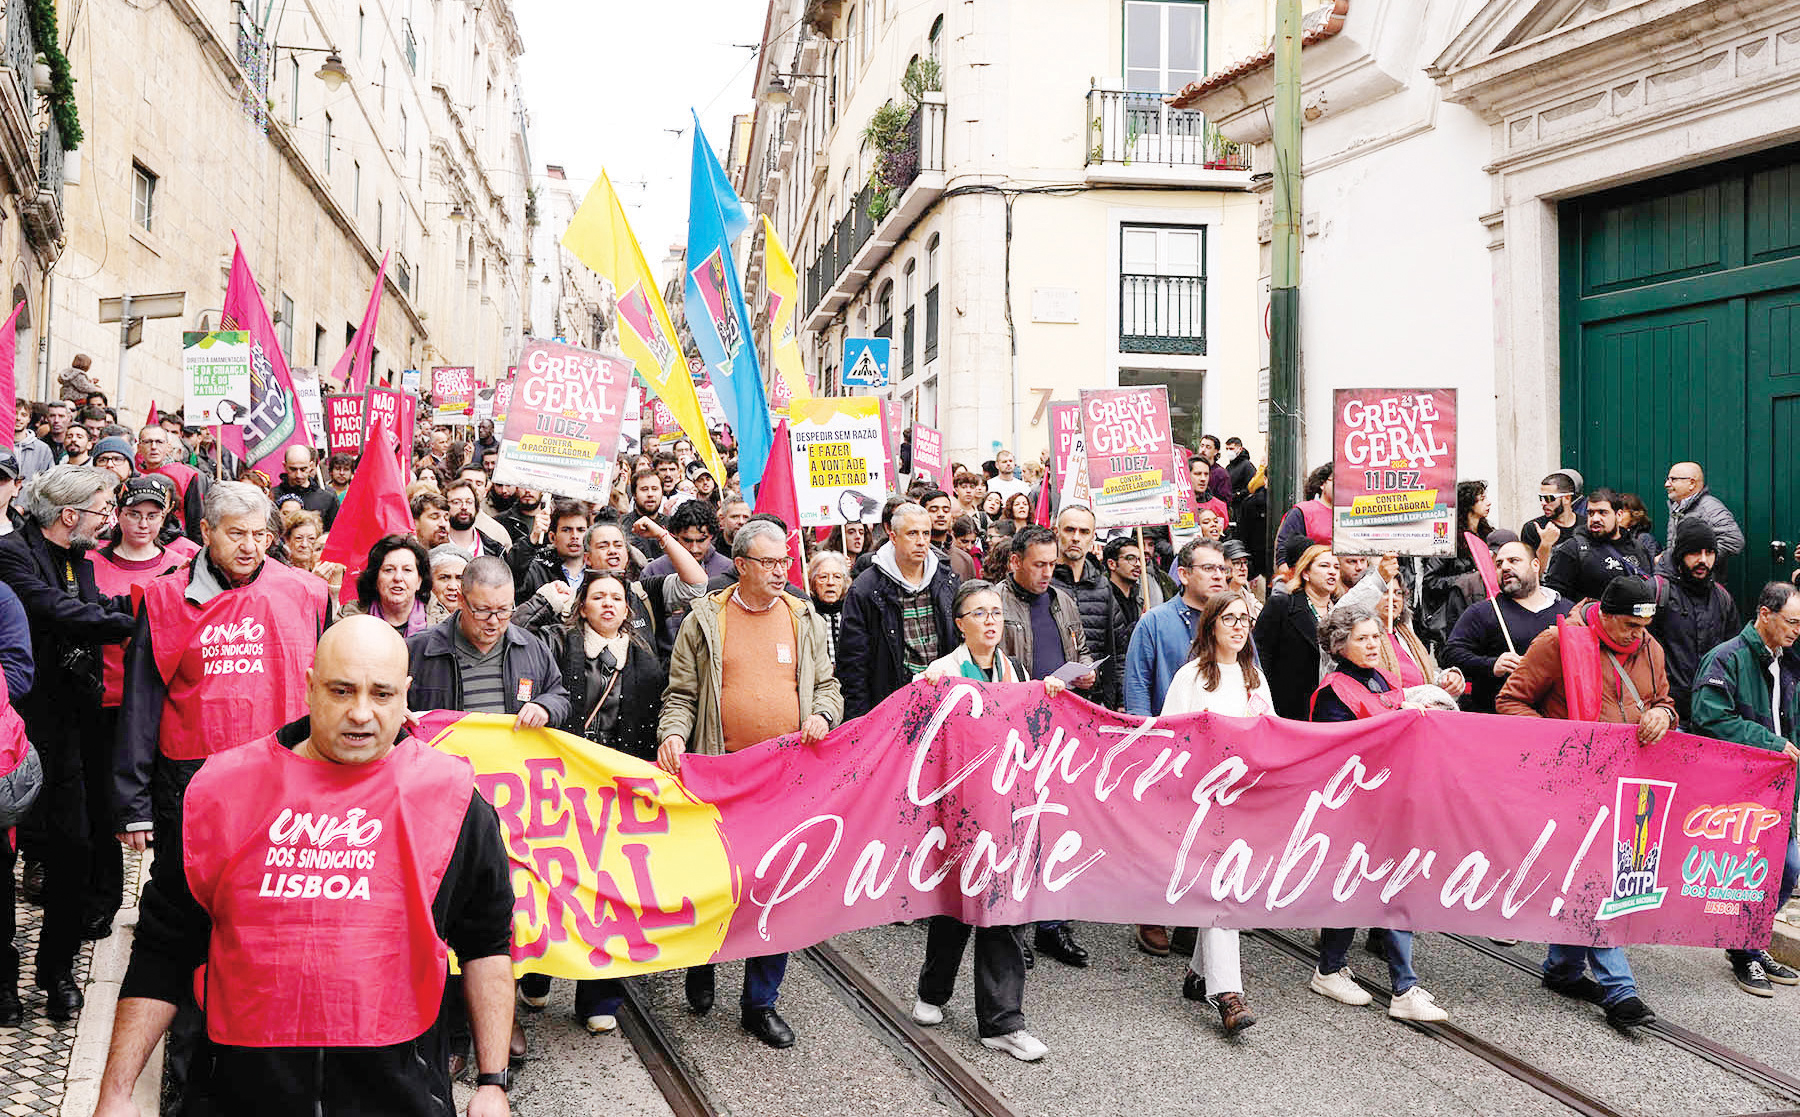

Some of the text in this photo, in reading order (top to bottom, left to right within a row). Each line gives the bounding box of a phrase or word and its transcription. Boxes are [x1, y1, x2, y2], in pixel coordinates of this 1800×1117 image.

[434, 368, 469, 382] GREVE
[528, 350, 614, 392] GREVE
[435, 380, 472, 396] GERAL
[333, 398, 357, 416] NÃO
[372, 392, 395, 411] NÃO
[522, 377, 616, 423] GERAL
[1031, 387, 1054, 426] 7
[1088, 392, 1157, 427] GREVE
[536, 412, 551, 432] 11
[1343, 394, 1440, 435] GREVE
[542, 437, 573, 448] CONTRA
[796, 427, 878, 443] DESPEDIR SEM RAZÃO
[1092, 416, 1166, 455] GERAL
[521, 443, 592, 459] O PACOTE LABORAL
[818, 444, 850, 457] FAZER
[1344, 423, 1449, 469] GERAL
[820, 458, 865, 472] VONTADE
[1109, 455, 1154, 474] 11 DEZ.
[812, 474, 825, 486] AO
[1105, 486, 1111, 495] O
[1111, 482, 1133, 494] PACOTE
[1133, 479, 1160, 491] LABORAL
[1119, 474, 1143, 485] CONTRA
[1365, 471, 1425, 490] 11 DEZ.
[1355, 501, 1431, 515] O PACOTE LABORAL
[1375, 494, 1409, 504] CONTRA
[199, 616, 265, 645] UNIÃO
[202, 645, 220, 659] DOS
[1322, 753, 1392, 811] a
[474, 757, 670, 873] REVE
[1683, 802, 1782, 845] CGTP
[268, 807, 383, 850] UNIÃO
[265, 846, 377, 870] DOS SINDICATOS
[749, 786, 1107, 942] Pacote
[1681, 845, 1769, 890] UNIÃO
[258, 872, 371, 901] LISBOA
[1616, 871, 1655, 898] CGTP
[1681, 883, 1766, 902] DOS SINDICATOS
[508, 843, 696, 968] ERAL
[1704, 900, 1741, 916] LISBOA
